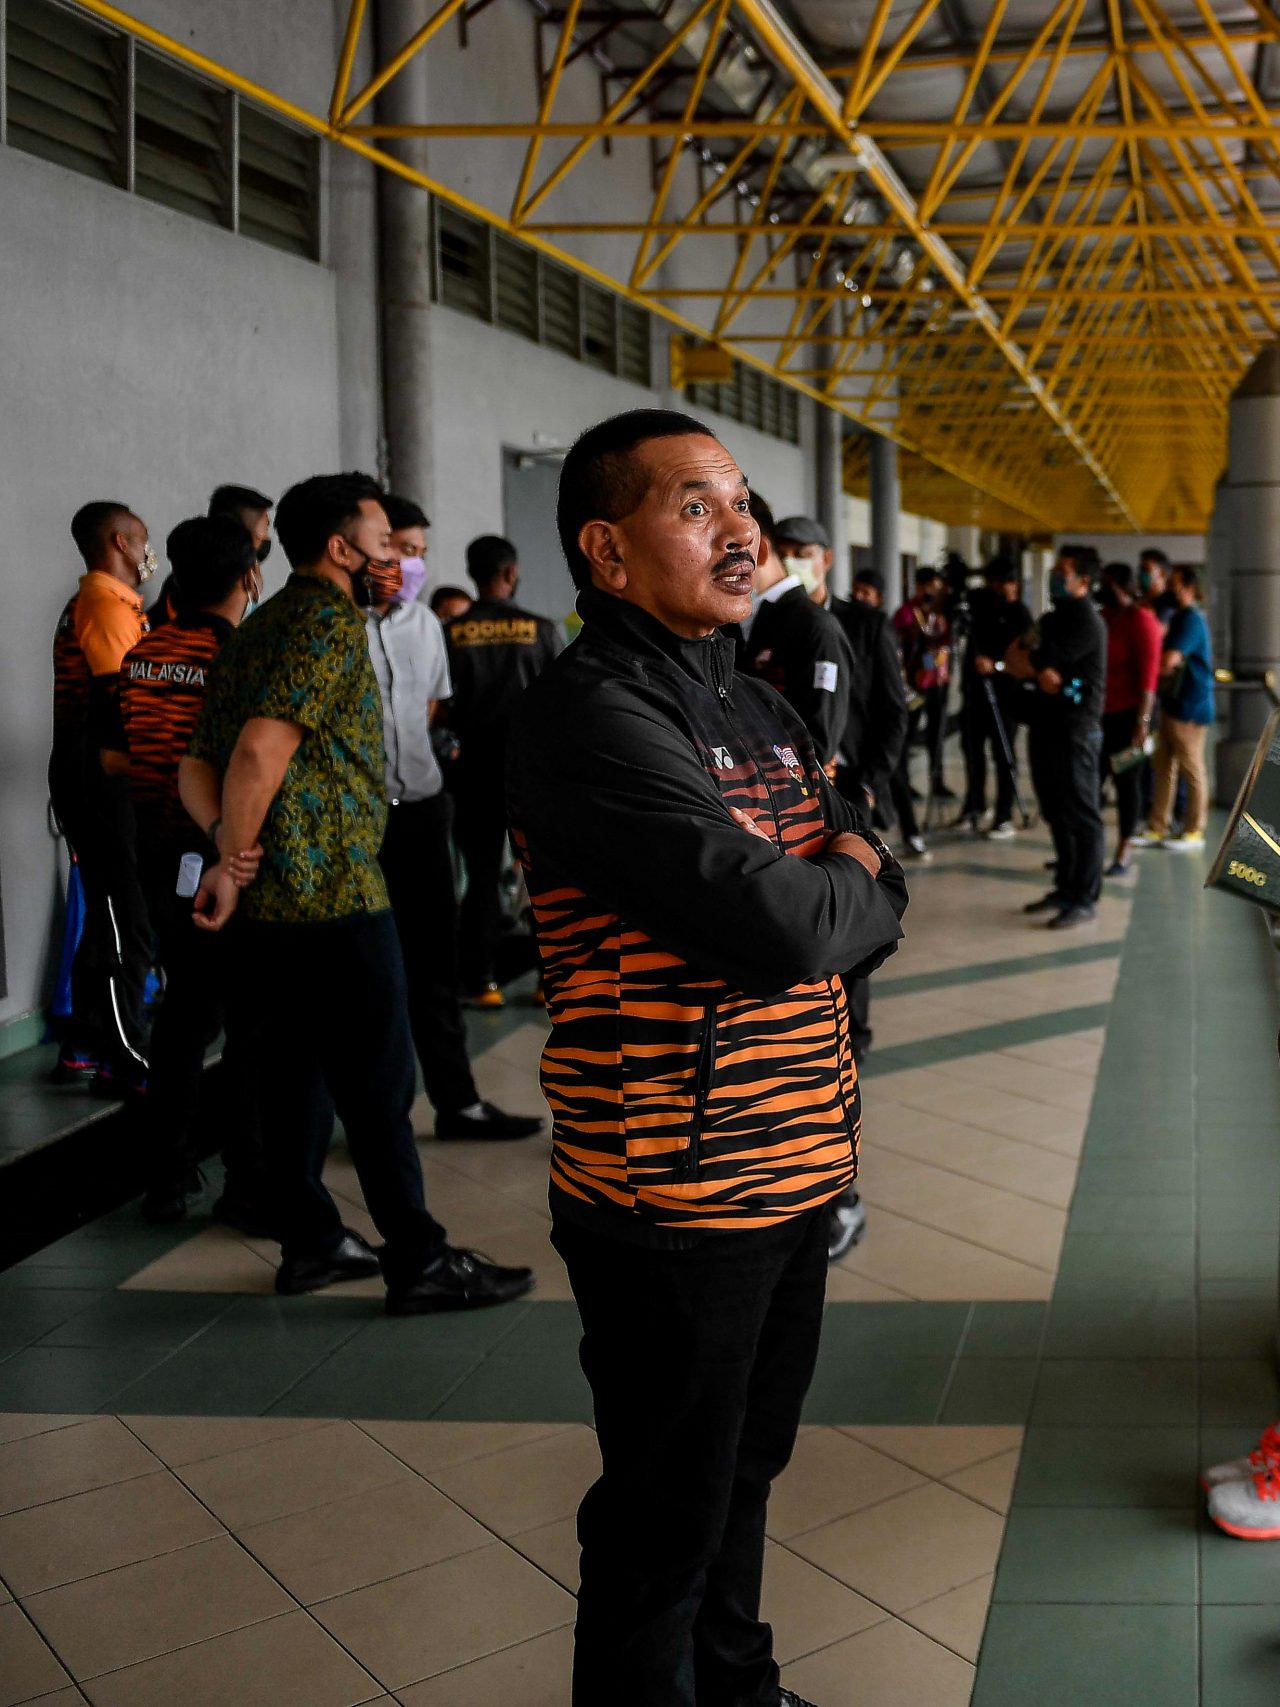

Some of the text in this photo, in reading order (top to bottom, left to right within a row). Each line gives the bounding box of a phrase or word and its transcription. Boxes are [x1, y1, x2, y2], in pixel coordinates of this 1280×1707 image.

[451, 619, 537, 639] PODIUM
[129, 661, 205, 687] MALAYSIA
[1228, 860, 1268, 887] 500G
